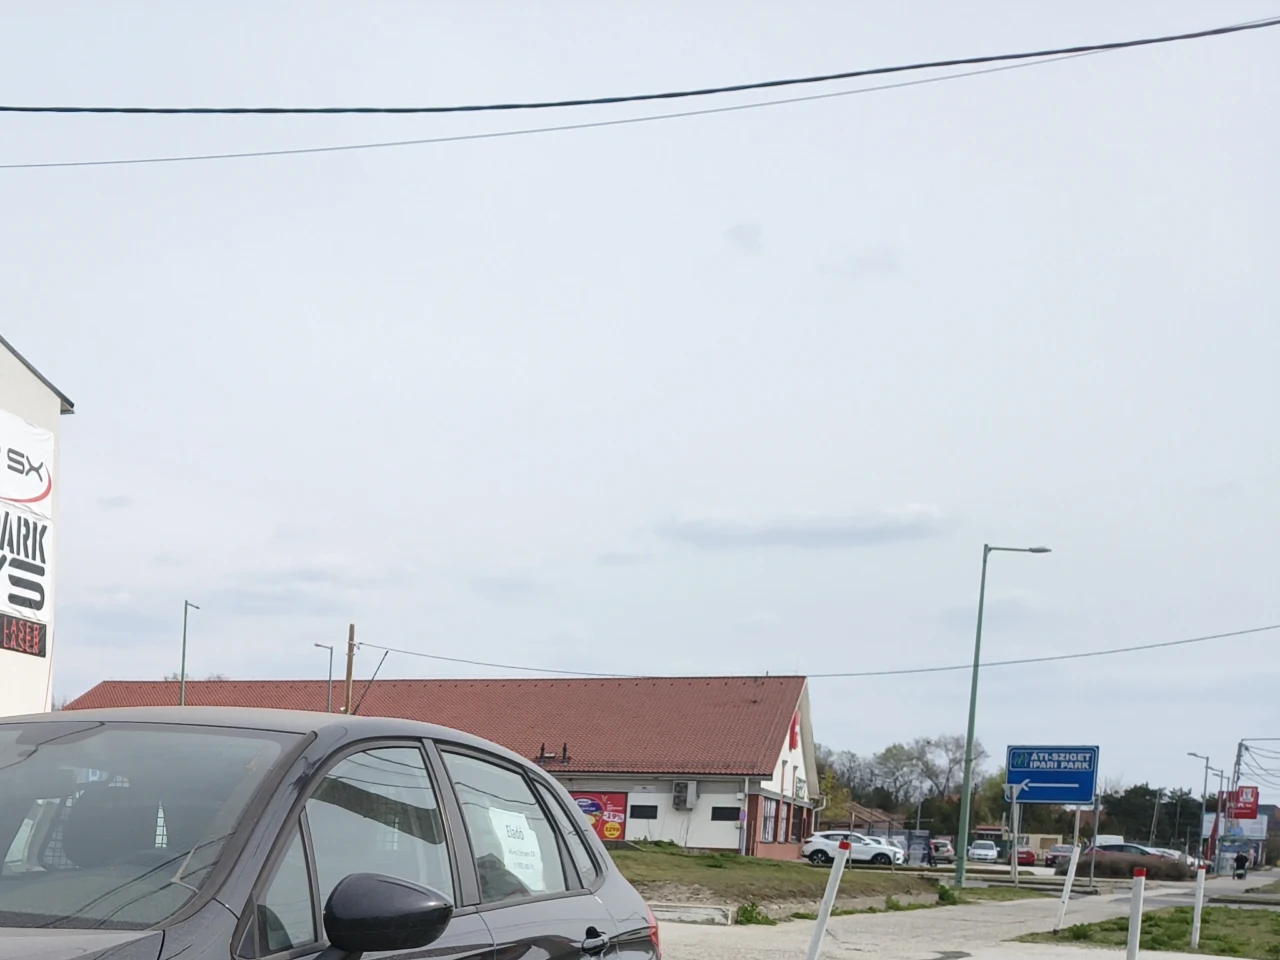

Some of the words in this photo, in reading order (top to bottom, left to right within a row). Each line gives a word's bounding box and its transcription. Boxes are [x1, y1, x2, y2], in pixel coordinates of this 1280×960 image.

[7, 447, 43, 483] SX
[1029, 761, 1058, 769] IPARI
[1061, 761, 1090, 769] PARK
